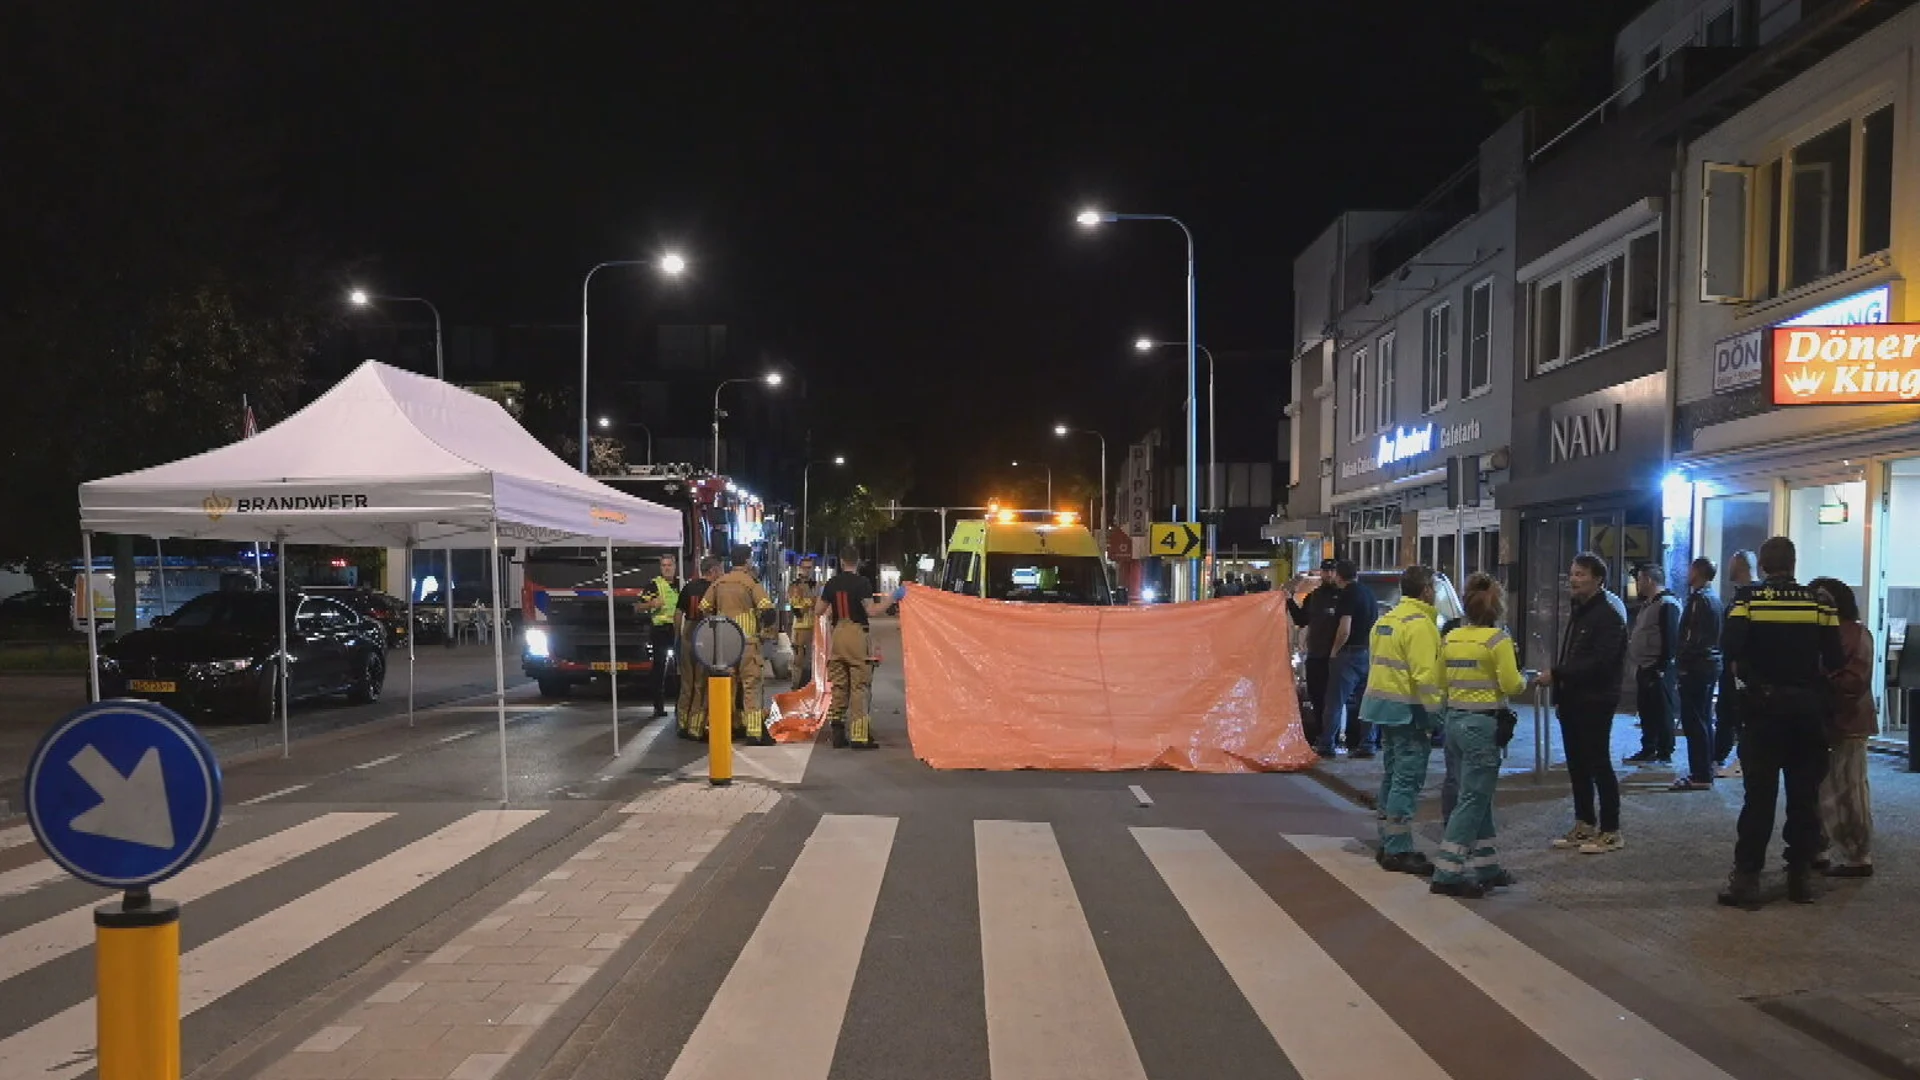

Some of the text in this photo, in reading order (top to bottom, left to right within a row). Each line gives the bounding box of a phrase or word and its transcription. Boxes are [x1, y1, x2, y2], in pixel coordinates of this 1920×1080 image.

[1718, 339, 1760, 373] DÖN
[1785, 329, 1920, 363] Döner
[1832, 362, 1920, 399] King
[1550, 405, 1619, 464] NAM
[1160, 531, 1177, 550] 4
